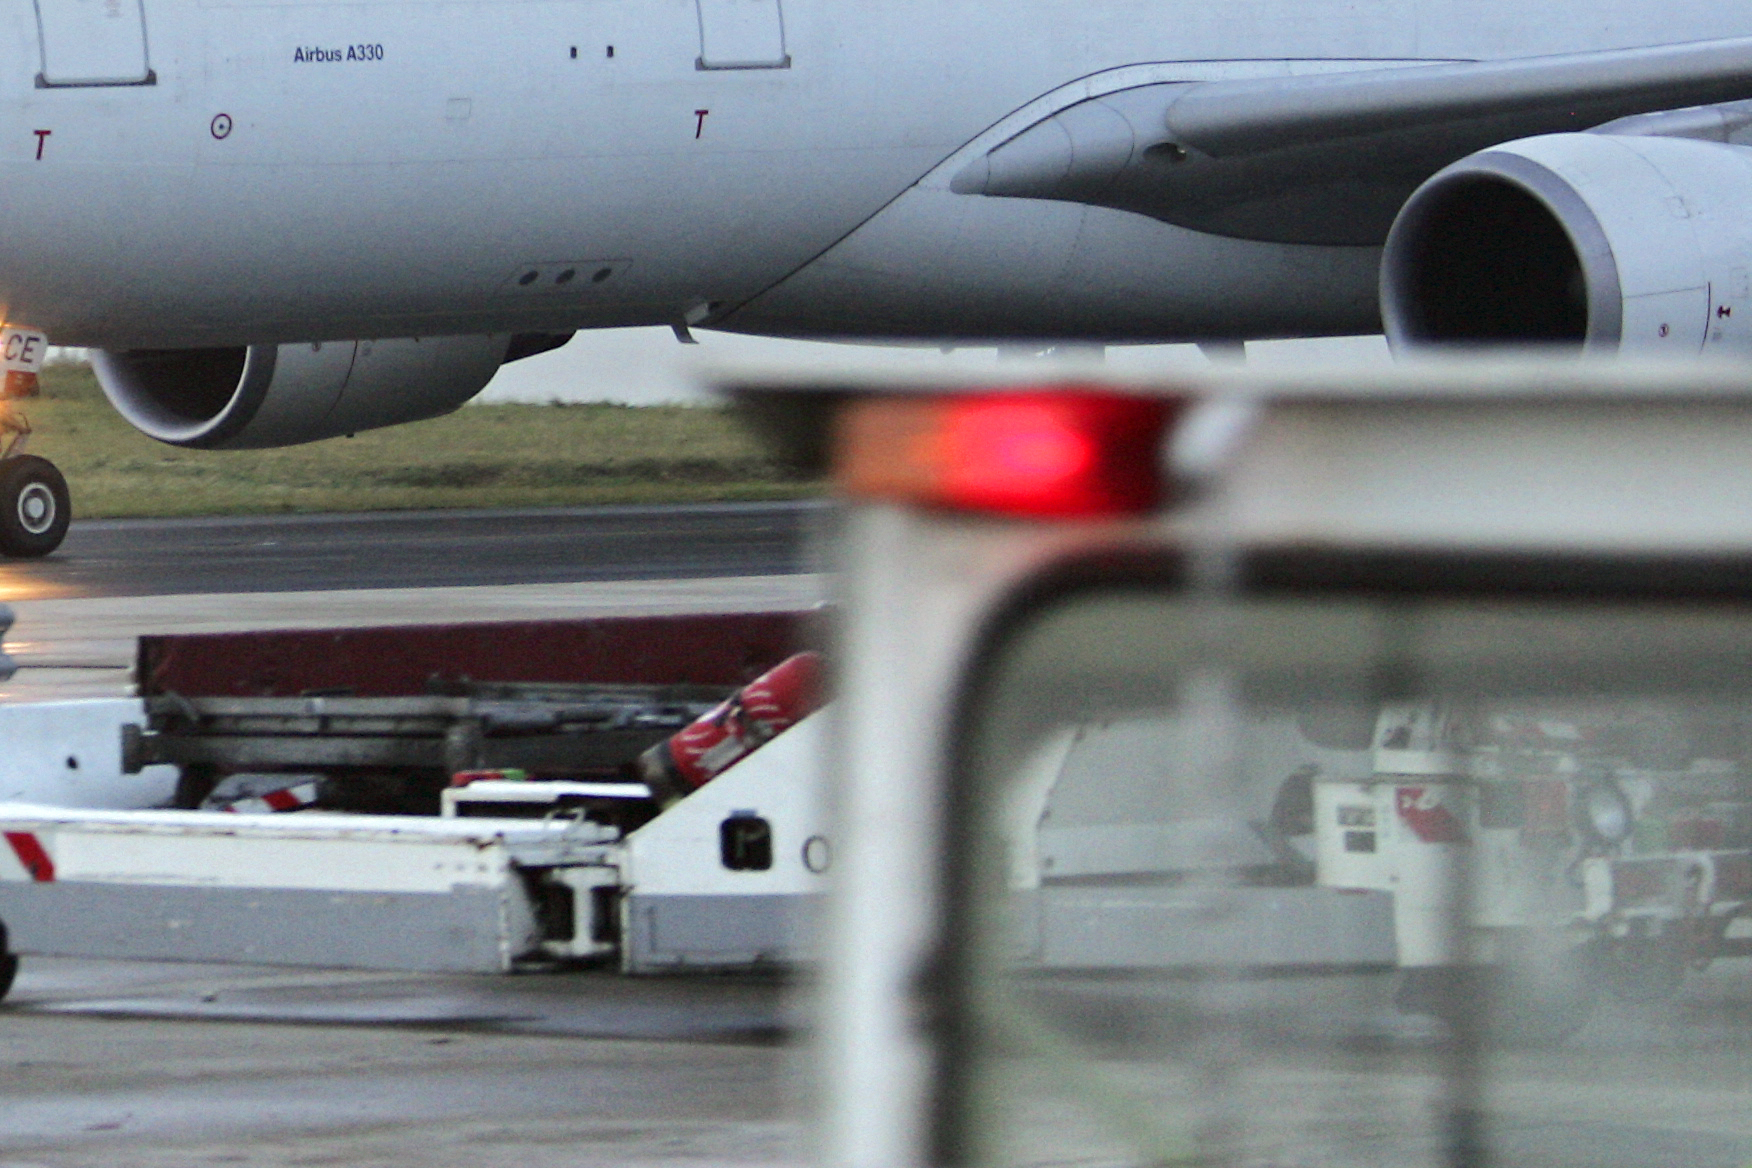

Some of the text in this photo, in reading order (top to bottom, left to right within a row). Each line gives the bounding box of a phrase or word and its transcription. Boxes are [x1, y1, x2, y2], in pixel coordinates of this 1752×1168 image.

[293, 43, 384, 63] Airbus A330
[5, 334, 41, 364] CE
